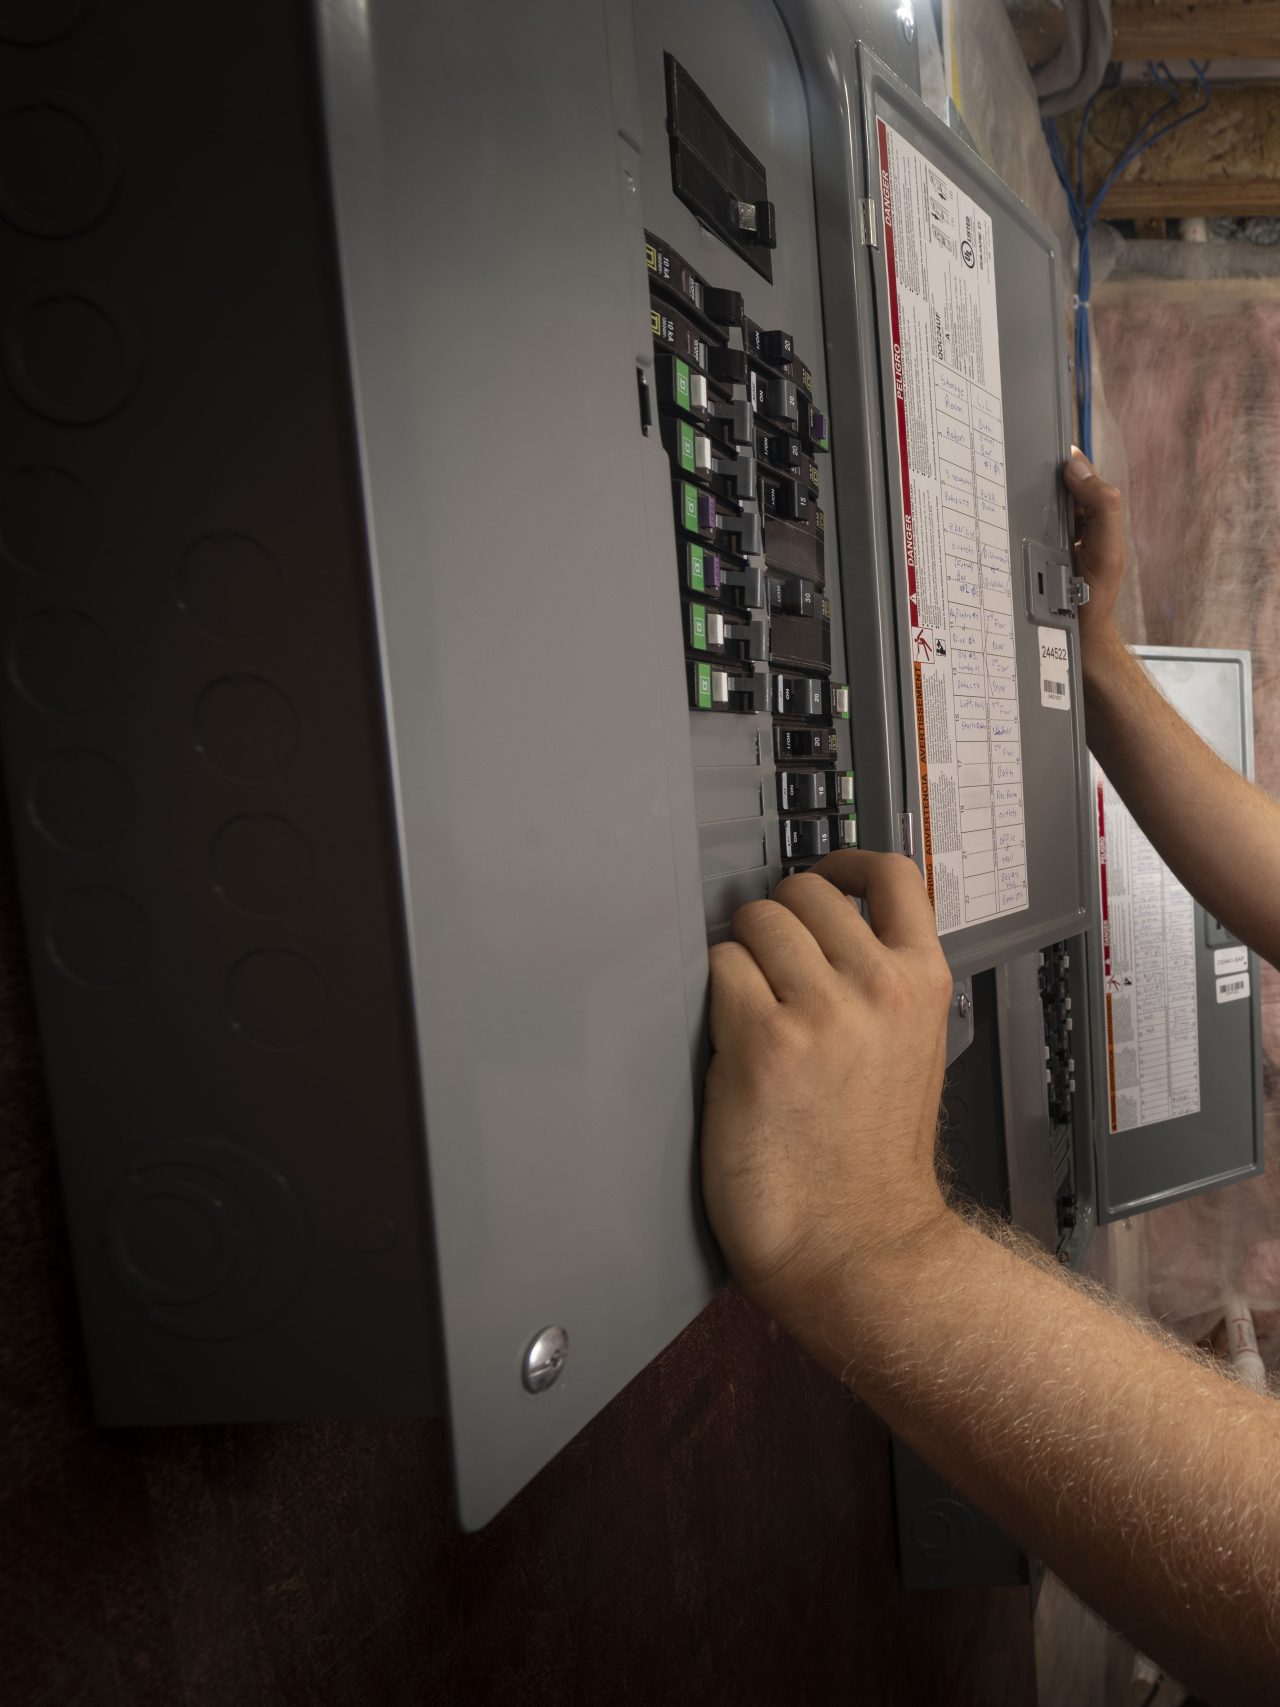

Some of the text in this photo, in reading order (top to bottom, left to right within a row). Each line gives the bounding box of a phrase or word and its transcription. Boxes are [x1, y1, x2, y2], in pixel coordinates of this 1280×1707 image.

[882, 169, 892, 226] DANGER
[664, 256, 670, 279] 10 kA
[668, 320, 674, 342] 10 kA
[935, 311, 944, 360] QOC24UF
[784, 340, 791, 352] 20
[893, 344, 904, 400] PELIGRO
[790, 396, 795, 406] 20
[792, 446, 798, 456] 20
[800, 496, 807, 506] 15
[905, 514, 915, 567] DANGER
[804, 592, 811, 603] 30
[1042, 646, 1068, 661] 244522
[786, 688, 790, 700] ON
[814, 693, 820, 702] 20
[914, 666, 927, 764] AVERTISSEMENT
[814, 737, 820, 746] 20
[921, 774, 932, 856] ADVERTENCIA
[926, 864, 936, 912] ARNING
